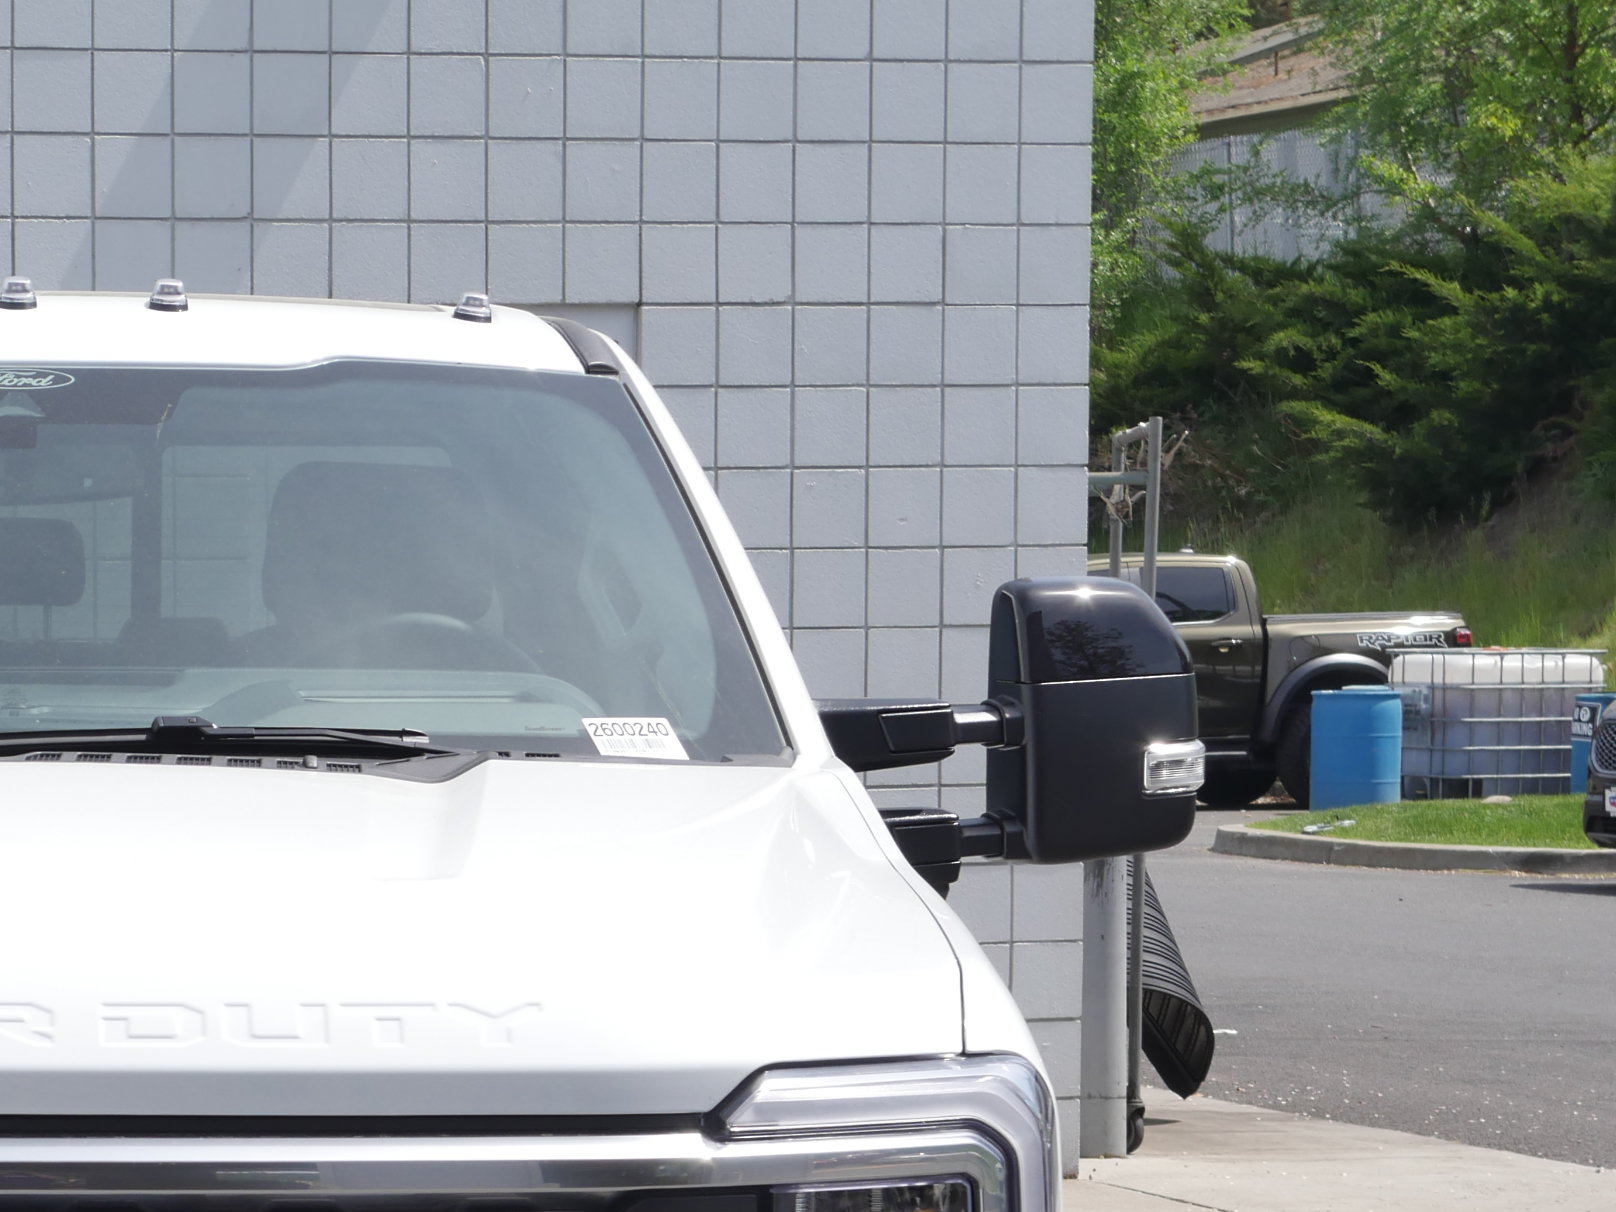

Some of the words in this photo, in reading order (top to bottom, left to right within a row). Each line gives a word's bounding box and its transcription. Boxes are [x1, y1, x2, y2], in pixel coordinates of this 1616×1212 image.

[1356, 632, 1448, 651] RAPTOR
[588, 722, 669, 737] 2600240
[97, 1002, 544, 1049] DUTY
